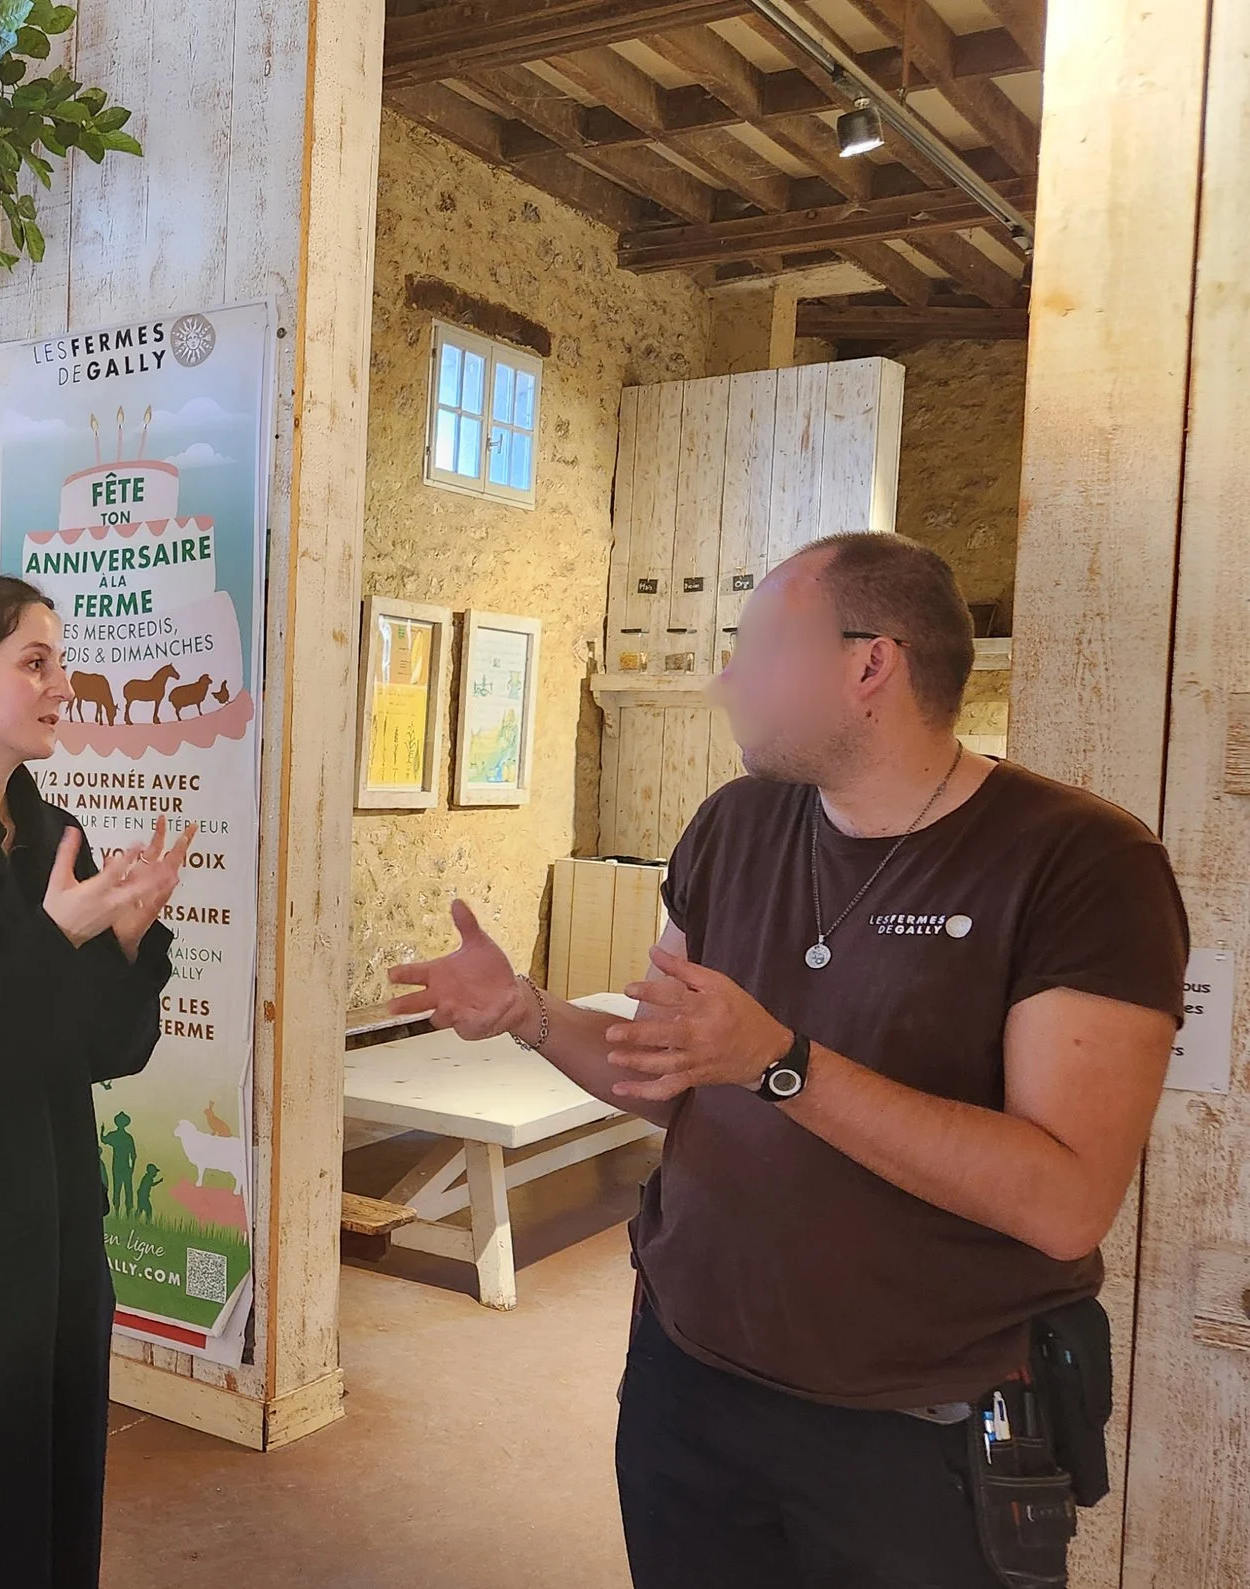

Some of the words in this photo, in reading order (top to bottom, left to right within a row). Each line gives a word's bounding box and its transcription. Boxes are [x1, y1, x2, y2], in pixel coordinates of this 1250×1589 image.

[92, 471, 145, 507] FÊTE
[100, 510, 131, 526] TON
[25, 535, 211, 574] ANNIVERSAIRE
[98, 573, 108, 588] À
[110, 575, 127, 588] LA
[73, 589, 153, 617] FERME
[63, 623, 79, 640] ES
[83, 617, 179, 641] MERCREDIS,
[95, 647, 106, 664] &
[111, 634, 214, 663] DIMANCHES
[34, 770, 58, 789] 1/2
[63, 769, 146, 790] JOURNÉE
[152, 775, 200, 791] AVEC
[45, 793, 69, 808] UN
[76, 794, 183, 813] ANIMATEUR
[103, 816, 117, 829] ET
[125, 817, 144, 830] EN
[157, 904, 231, 925] RSAIRE
[171, 965, 204, 980] ALLY
[1183, 982, 1211, 993] ous
[179, 997, 210, 1016] LES
[1184, 1003, 1204, 1015] es
[159, 1018, 215, 1041] ERME
[103, 1232, 121, 1246] en
[126, 1229, 166, 1261] ligne
